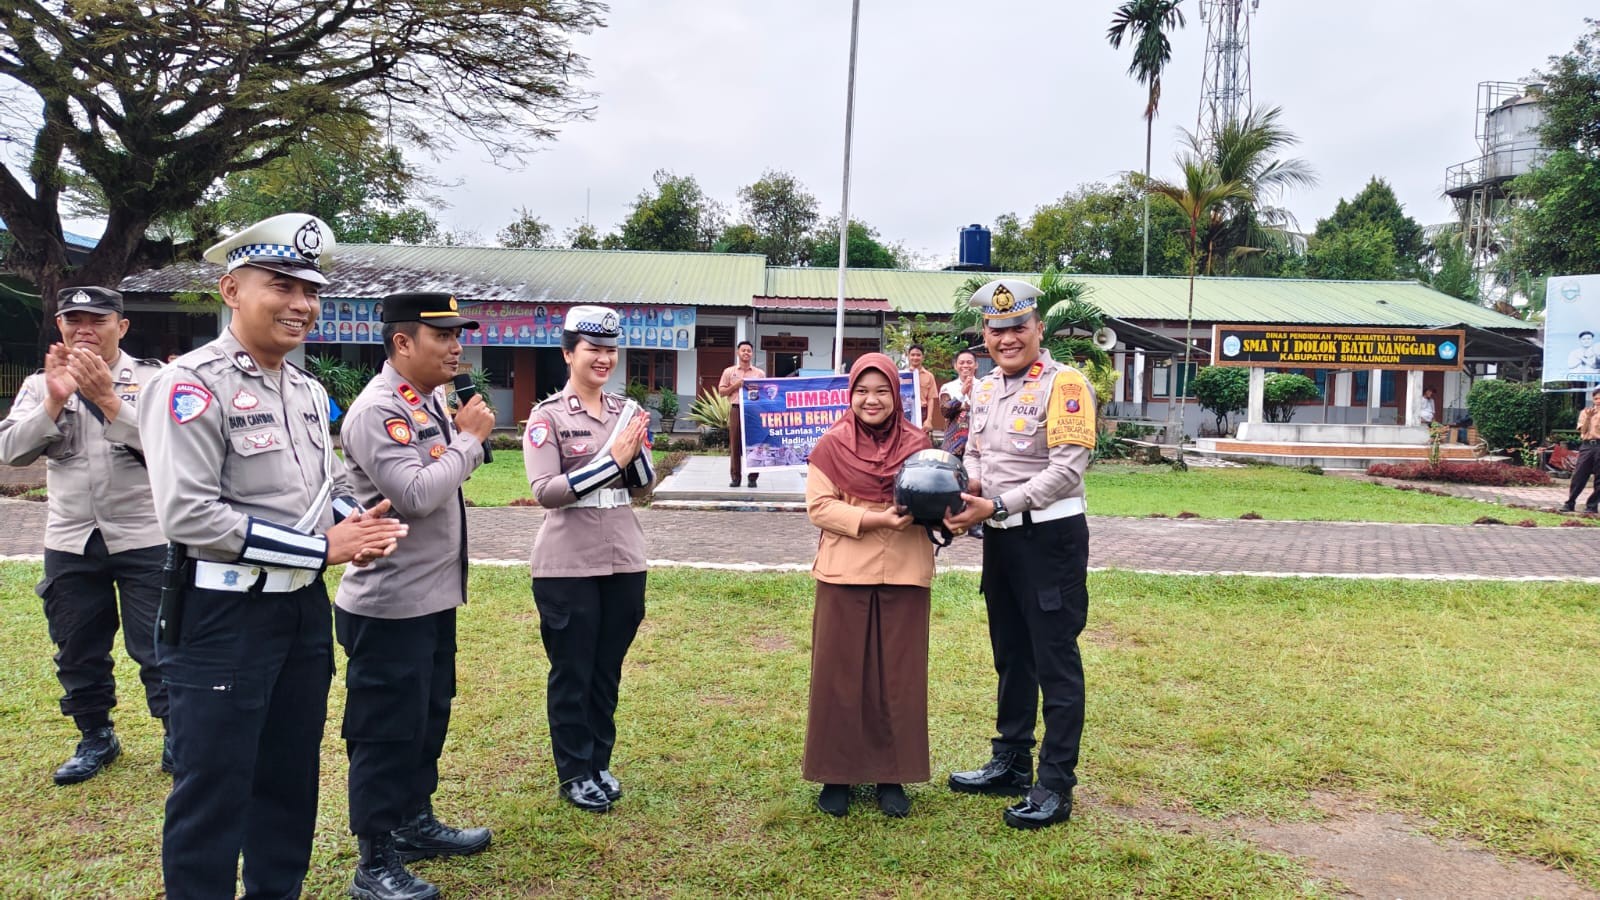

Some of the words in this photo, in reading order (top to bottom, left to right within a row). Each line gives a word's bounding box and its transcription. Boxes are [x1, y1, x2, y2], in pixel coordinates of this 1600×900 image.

[1243, 339, 1268, 352] SMA
[1271, 340, 1280, 352] N
[1283, 340, 1289, 352] 1
[1294, 340, 1338, 354] DOLOK
[1340, 341, 1375, 354] BATU
[1377, 342, 1437, 356] NANGGAR
[1280, 353, 1336, 362] KABUPATEN
[1340, 354, 1400, 363] SIMALUNGUN
[785, 389, 850, 408] HIMBAU
[1010, 405, 1039, 416] POLRI
[303, 412, 319, 424] PO
[760, 411, 803, 428] TERTIB
[805, 409, 846, 426] BERLA
[769, 428, 783, 436] Sat
[785, 427, 813, 436] Lantas
[815, 426, 829, 434] Pol
[781, 437, 805, 445] Hadir
